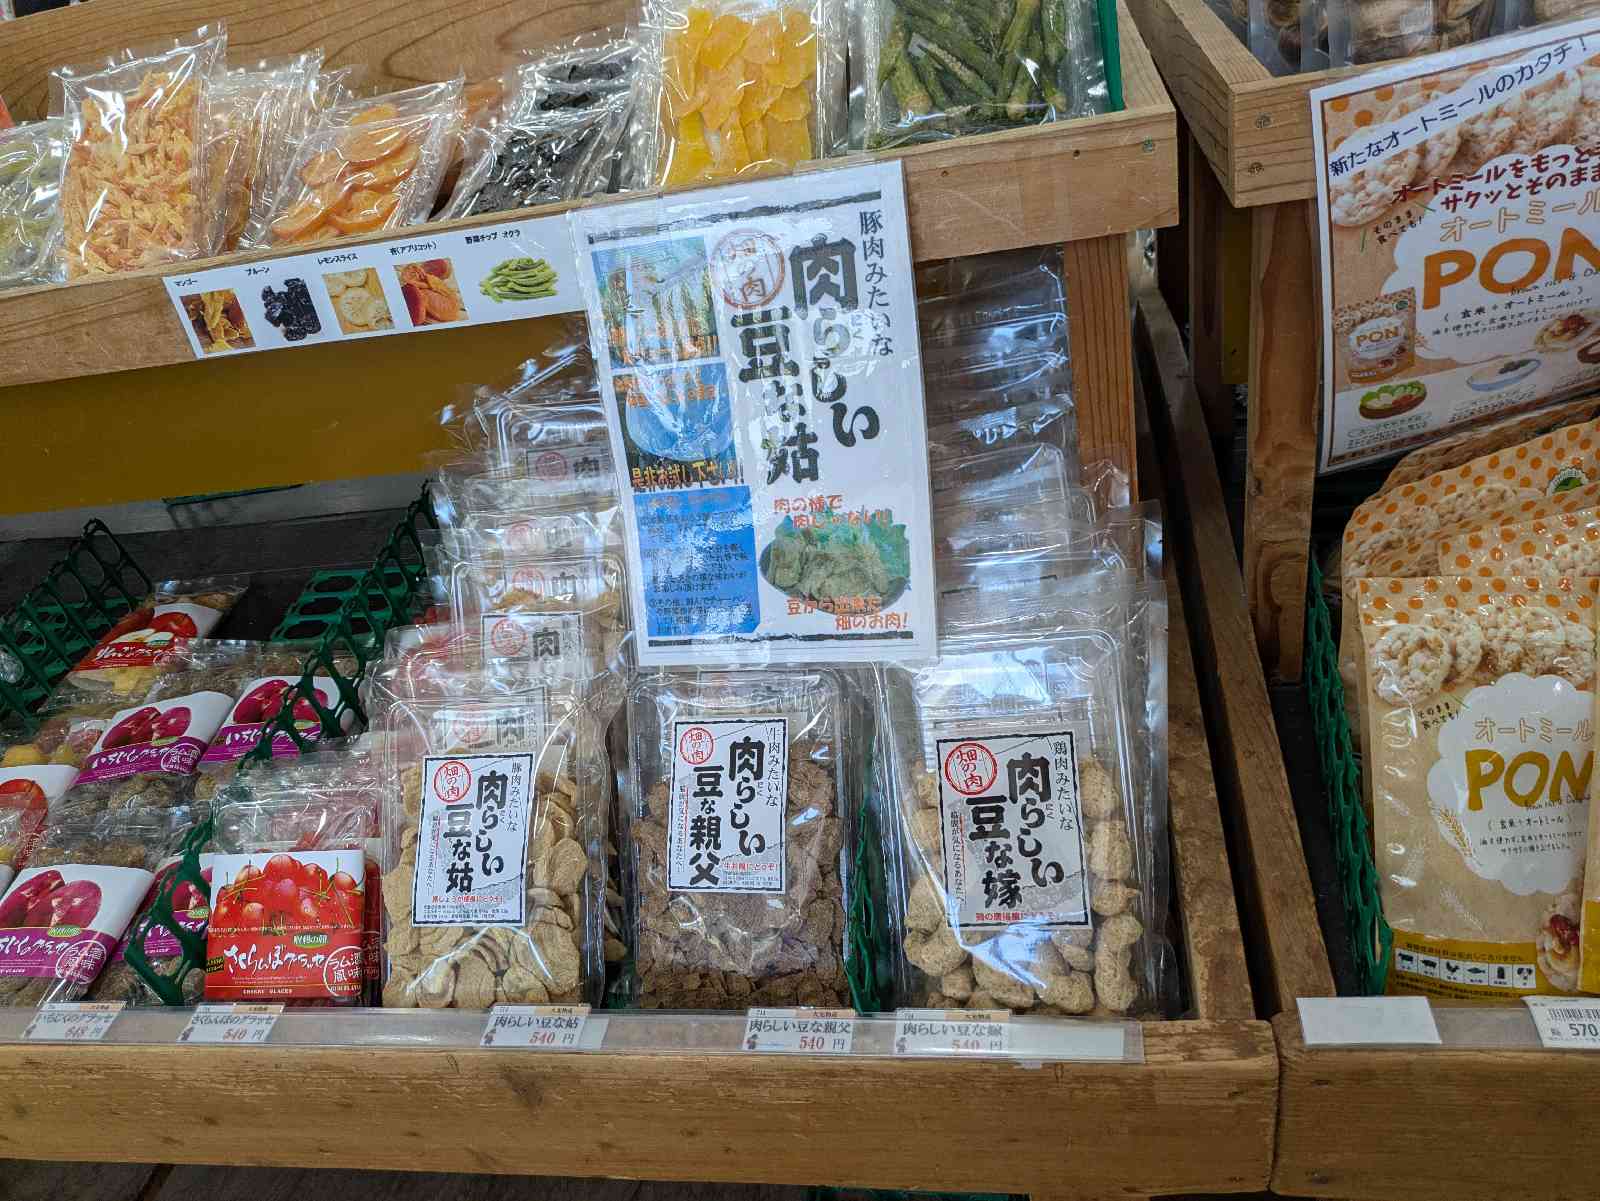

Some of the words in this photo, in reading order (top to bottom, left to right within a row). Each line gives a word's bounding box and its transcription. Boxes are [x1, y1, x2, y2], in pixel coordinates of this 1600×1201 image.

[1392, 143, 1600, 205] オートミールをもっと
[244, 266, 271, 276] プルーン
[317, 252, 359, 265] レモンスライス
[174, 279, 199, 288] マンゴー
[859, 210, 894, 357] 豚肉みたいな
[789, 233, 881, 448] 肉らしい
[1356, 325, 1400, 347] PON
[1474, 717, 1594, 743] オートミール
[443, 766, 461, 799] 畑の肉
[956, 749, 984, 790] 畑の肉
[1053, 740, 1074, 832] 鶏肉みたいな
[1465, 749, 1594, 811] PON
[728, 735, 767, 857] 肉らしい
[475, 770, 509, 877] 肉らしい
[689, 765, 725, 886] 豆な親父
[1006, 752, 1065, 888] 肉らしい
[443, 803, 475, 893] 豆な姑
[965, 794, 1023, 909] 豆な嫁
[494, 1015, 580, 1029] 肉らしい豆な姑
[529, 1031, 556, 1044] 540
[749, 1019, 852, 1034] 肉らしい豆な親父
[1568, 1023, 1599, 1037] 570
[799, 1036, 825, 1050] 540
[832, 1038, 845, 1050] 円
